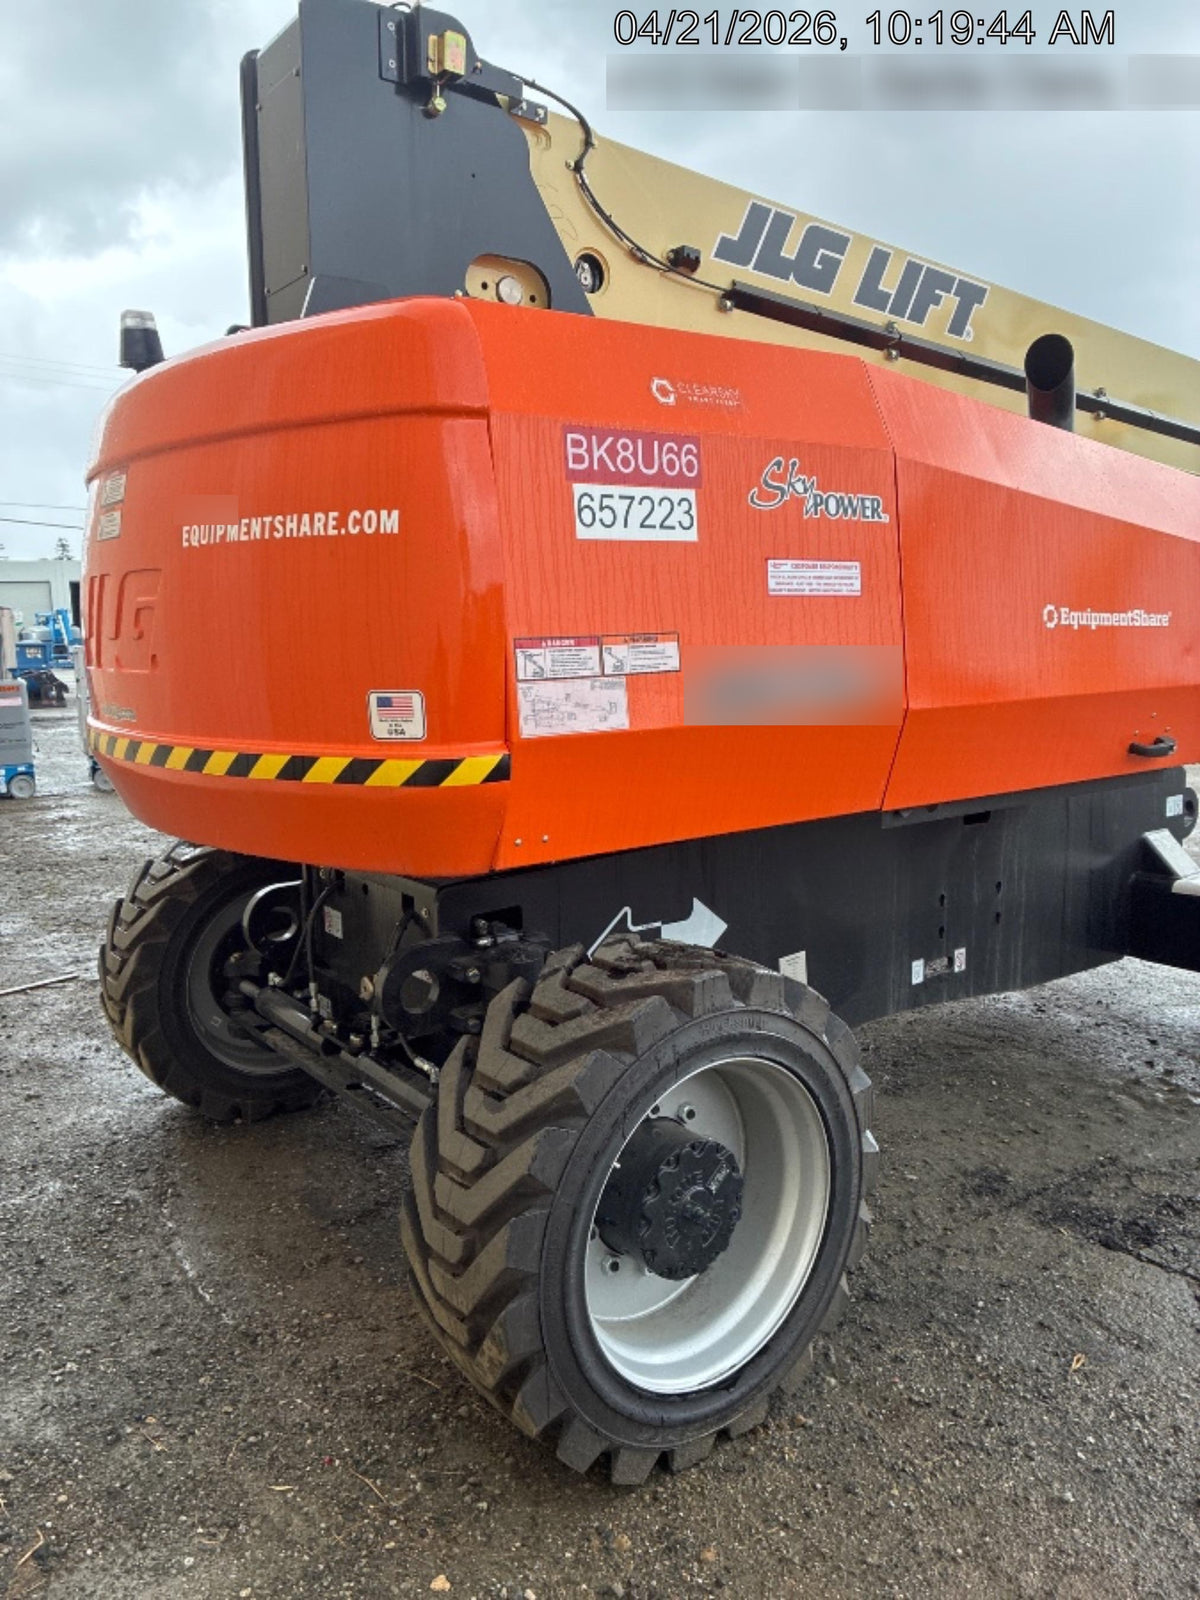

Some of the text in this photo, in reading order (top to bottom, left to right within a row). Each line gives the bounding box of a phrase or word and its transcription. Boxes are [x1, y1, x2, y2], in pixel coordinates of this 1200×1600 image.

[711, 199, 991, 342] JLG LIFT
[566, 432, 698, 478] BK8U66
[182, 508, 400, 548] EQUIPMENTSHARE.COM
[577, 491, 694, 531] 657223
[1059, 607, 1170, 630] EquipmentShare
